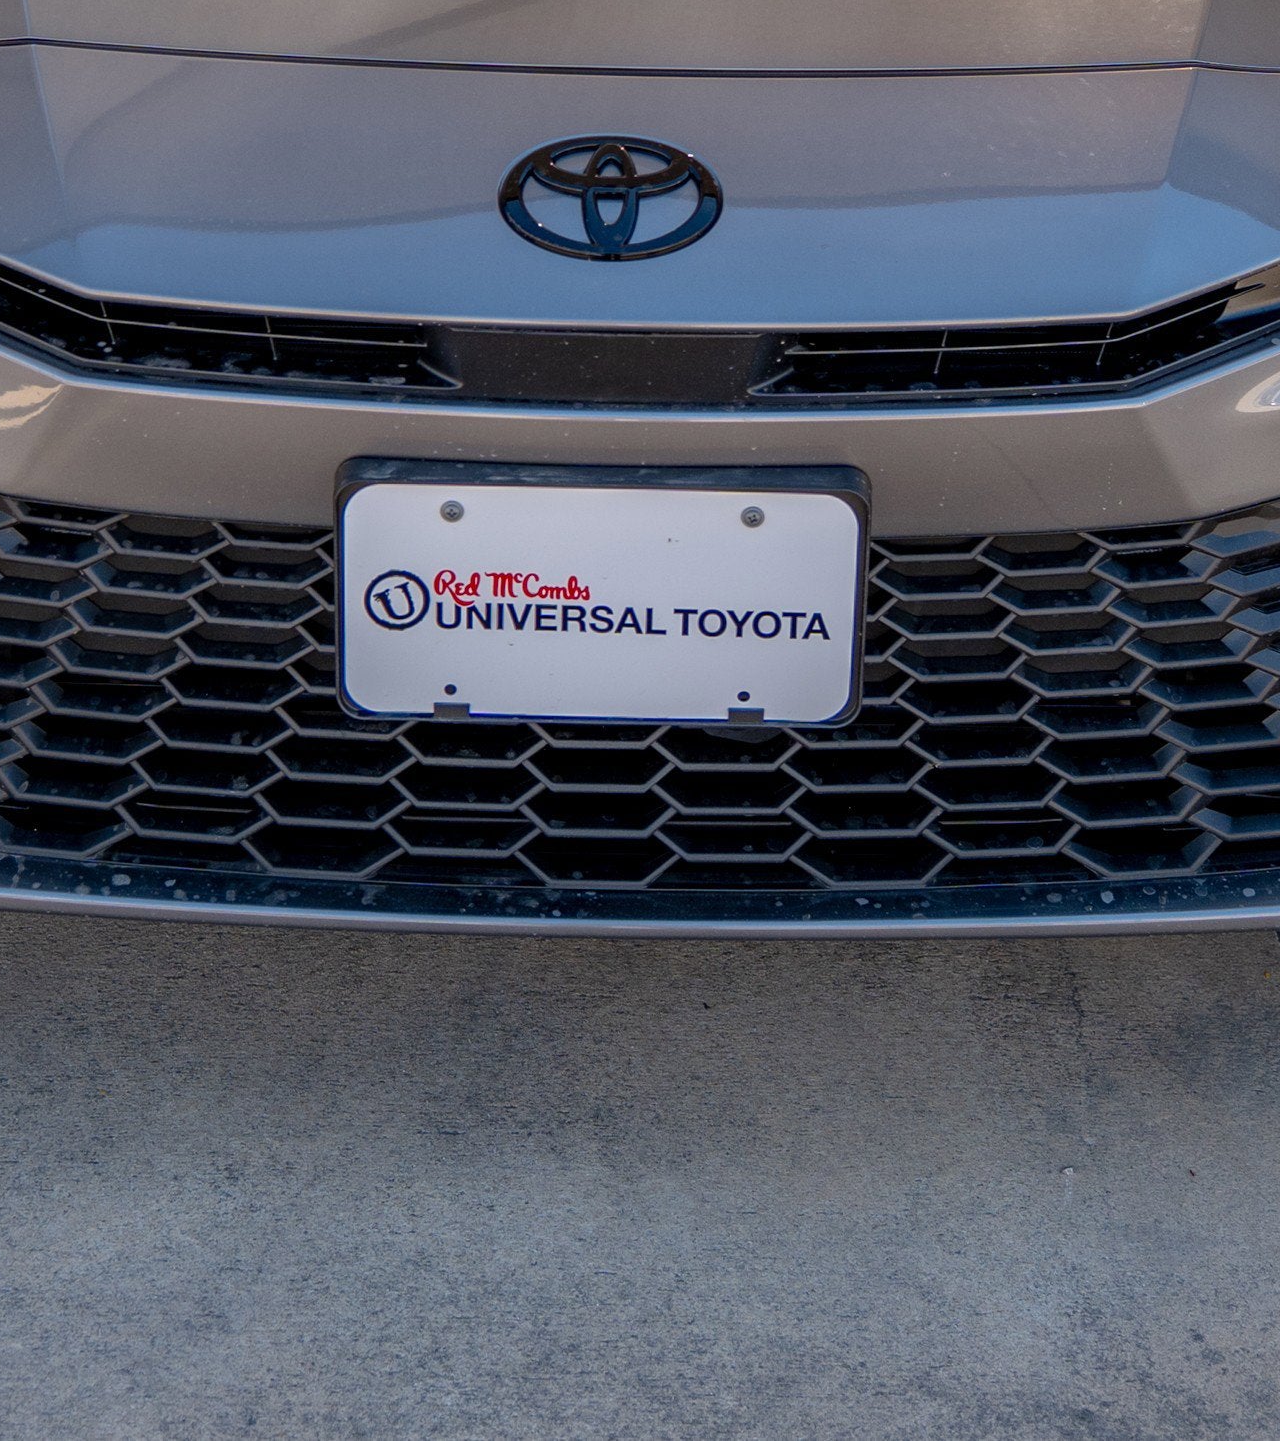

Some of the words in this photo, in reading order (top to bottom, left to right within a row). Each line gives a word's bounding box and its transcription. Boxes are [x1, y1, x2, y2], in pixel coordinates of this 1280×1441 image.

[434, 570, 480, 606] Red
[486, 571, 590, 601] McCombs
[436, 602, 667, 635] UNIVERSAL
[673, 608, 830, 640] TOYOTA
